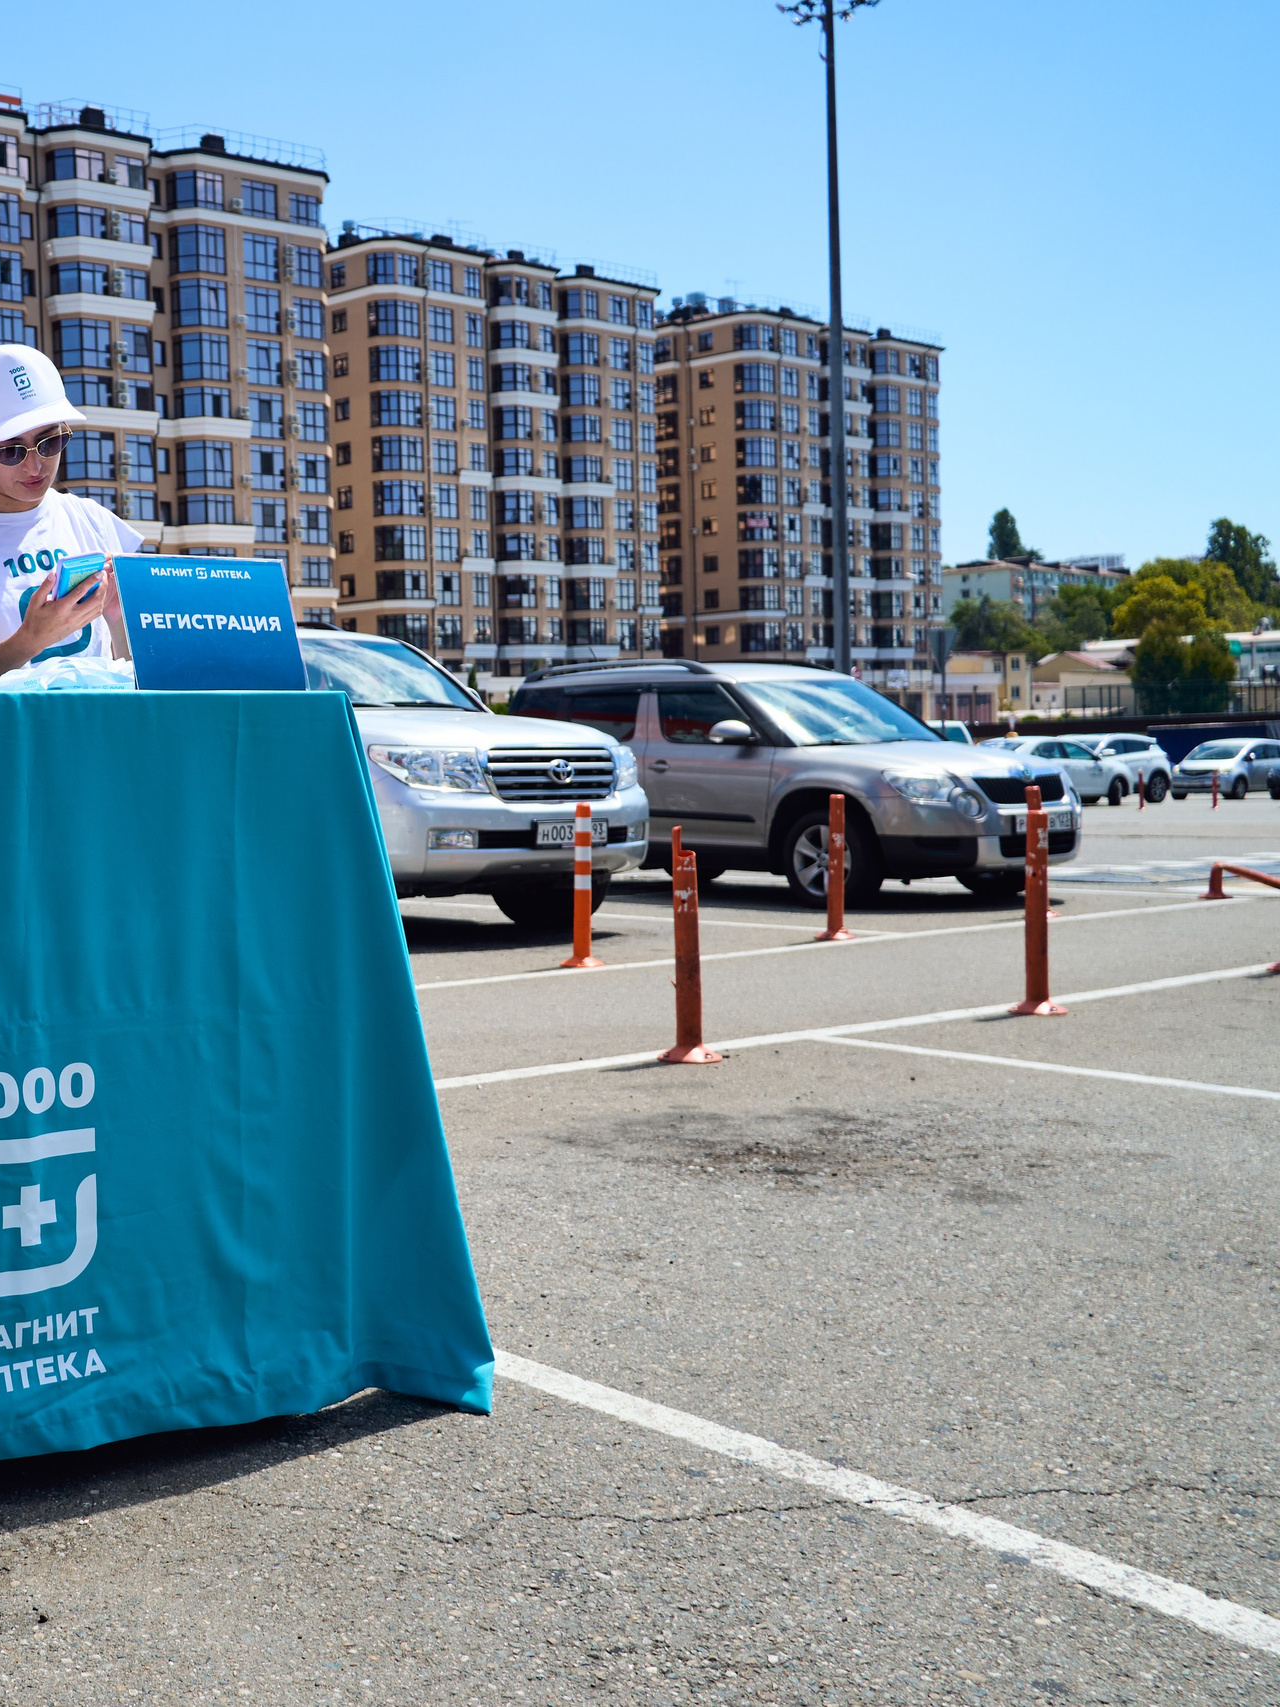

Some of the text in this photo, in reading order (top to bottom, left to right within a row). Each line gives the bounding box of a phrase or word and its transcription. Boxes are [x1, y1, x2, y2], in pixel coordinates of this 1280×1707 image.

[9, 366, 25, 375] 1000
[150, 567, 252, 580] МАГНИТ АПТЕКА
[139, 613, 282, 634] РЕГИСТРАЦИЯ
